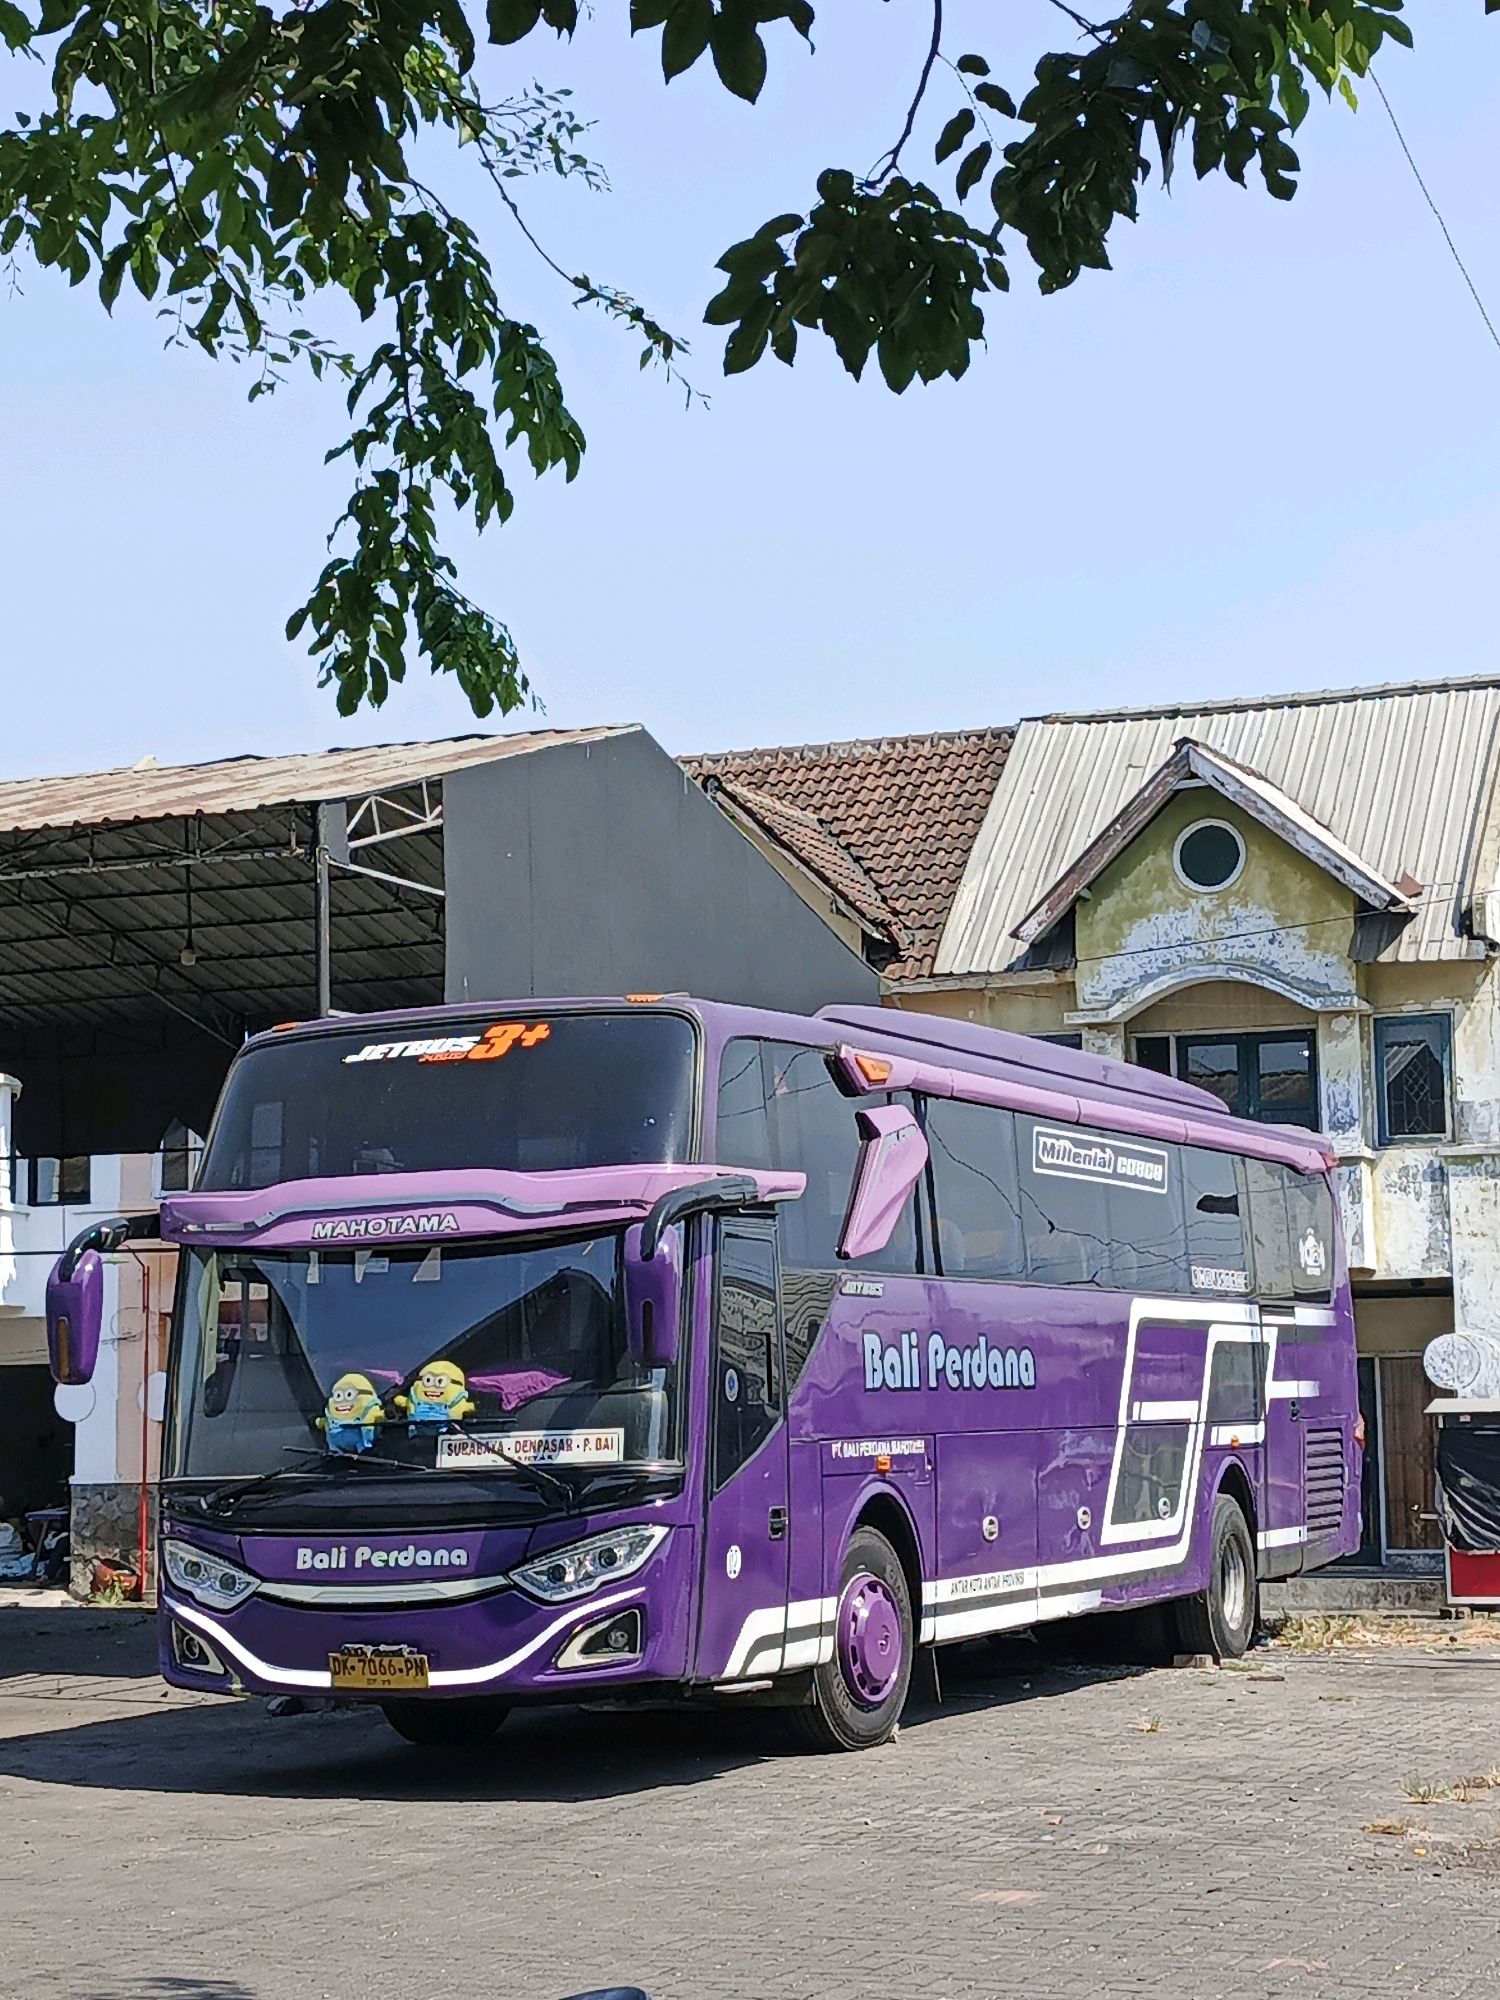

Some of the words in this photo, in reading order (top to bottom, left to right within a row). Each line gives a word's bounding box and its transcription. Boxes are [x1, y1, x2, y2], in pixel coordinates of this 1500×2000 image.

[341, 1036, 481, 1063] JETBUS
[467, 1022, 550, 1060] 3+
[313, 1213, 460, 1239] MAHOTAMA
[863, 1330, 920, 1391] Bali
[928, 1332, 1036, 1390] Perdana
[296, 1546, 347, 1570] Bali
[355, 1545, 469, 1568] Perdana
[332, 1658, 351, 1676] DK
[358, 1658, 396, 1676] 7066
